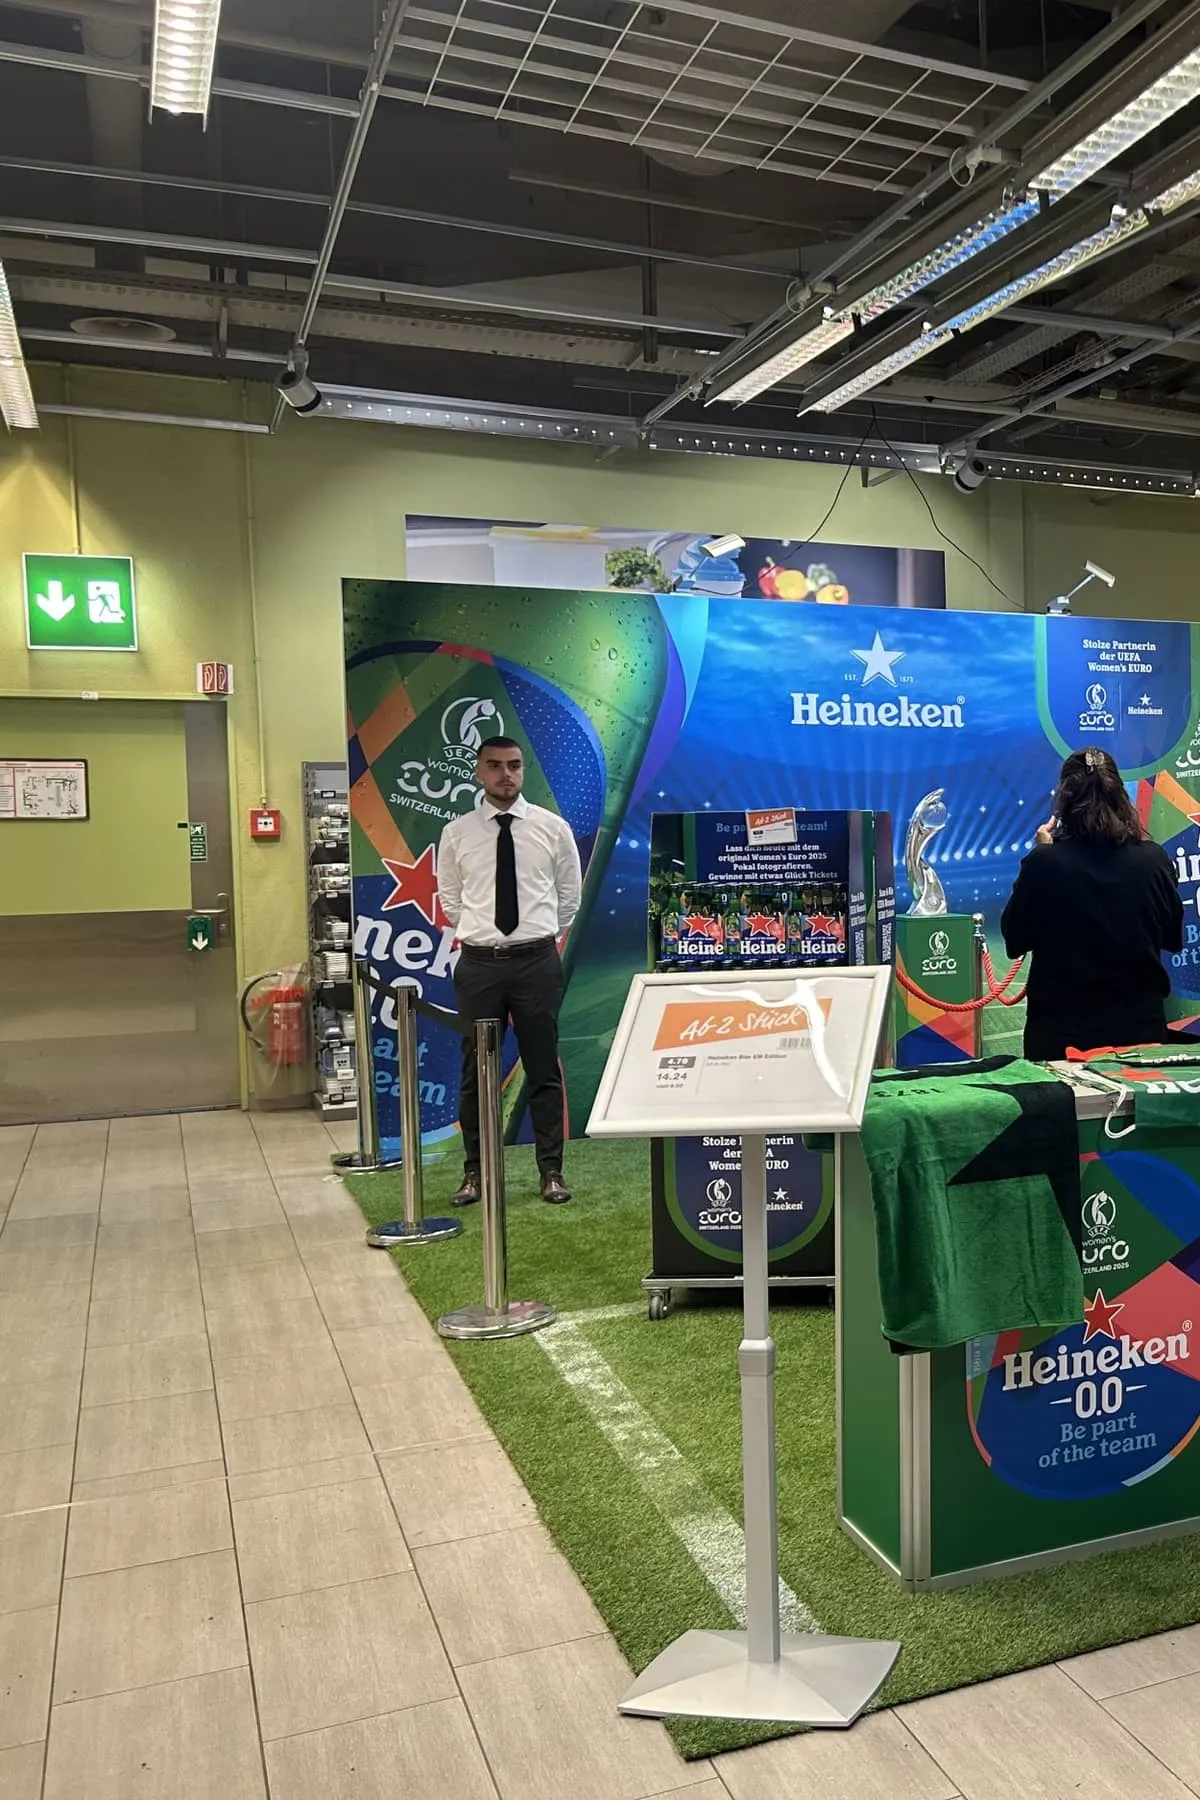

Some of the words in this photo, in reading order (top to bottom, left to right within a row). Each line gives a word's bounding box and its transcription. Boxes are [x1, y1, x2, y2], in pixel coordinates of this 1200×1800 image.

[1082, 639, 1111, 649] Stolze
[1112, 640, 1156, 651] Partnerin
[1099, 651, 1116, 661] der
[1117, 652, 1141, 661] UEFA
[1087, 662, 1127, 672] Women's
[1128, 663, 1153, 673] EURO
[790, 692, 966, 728] Heineken
[1127, 706, 1163, 715] Heineken
[389, 793, 463, 821] SWITZERLAN
[716, 822, 730, 832] Be
[733, 823, 746, 834] pa
[725, 845, 743, 853] Lass
[787, 844, 801, 852] mit
[802, 843, 820, 851] dem
[718, 854, 750, 862] original
[751, 853, 787, 861] Women's
[808, 852, 827, 860] 2025
[733, 863, 756, 871] Pokal
[757, 862, 813, 872] fotografieren.
[708, 873, 743, 881] Gewinne
[744, 872, 758, 880] mit
[759, 872, 784, 880] etwas
[785, 870, 807, 879] Glück
[808, 871, 838, 879] Tickets
[678, 940, 724, 955] Heine
[740, 939, 786, 955] Heine
[801, 940, 846, 955] Heine
[1171, 948, 1188, 967] of
[679, 1015, 716, 1041] Ab
[716, 1015, 736, 1035] 2
[738, 1007, 801, 1032] Stück
[656, 1072, 688, 1081] 14.24
[702, 1136, 736, 1147] Stolze
[723, 1149, 742, 1158] der
[709, 1161, 742, 1171] Wome
[765, 1159, 789, 1170] URO
[766, 1201, 803, 1211] eineken
[1082, 1240, 1130, 1264] uro
[1113, 1261, 1130, 1270] 2025
[1002, 1330, 1190, 1392] Heineken
[1059, 1422, 1087, 1443] Be
[1092, 1412, 1137, 1439] part
[1038, 1448, 1063, 1468] of
[1063, 1443, 1096, 1464] the
[1100, 1432, 1157, 1452] team
